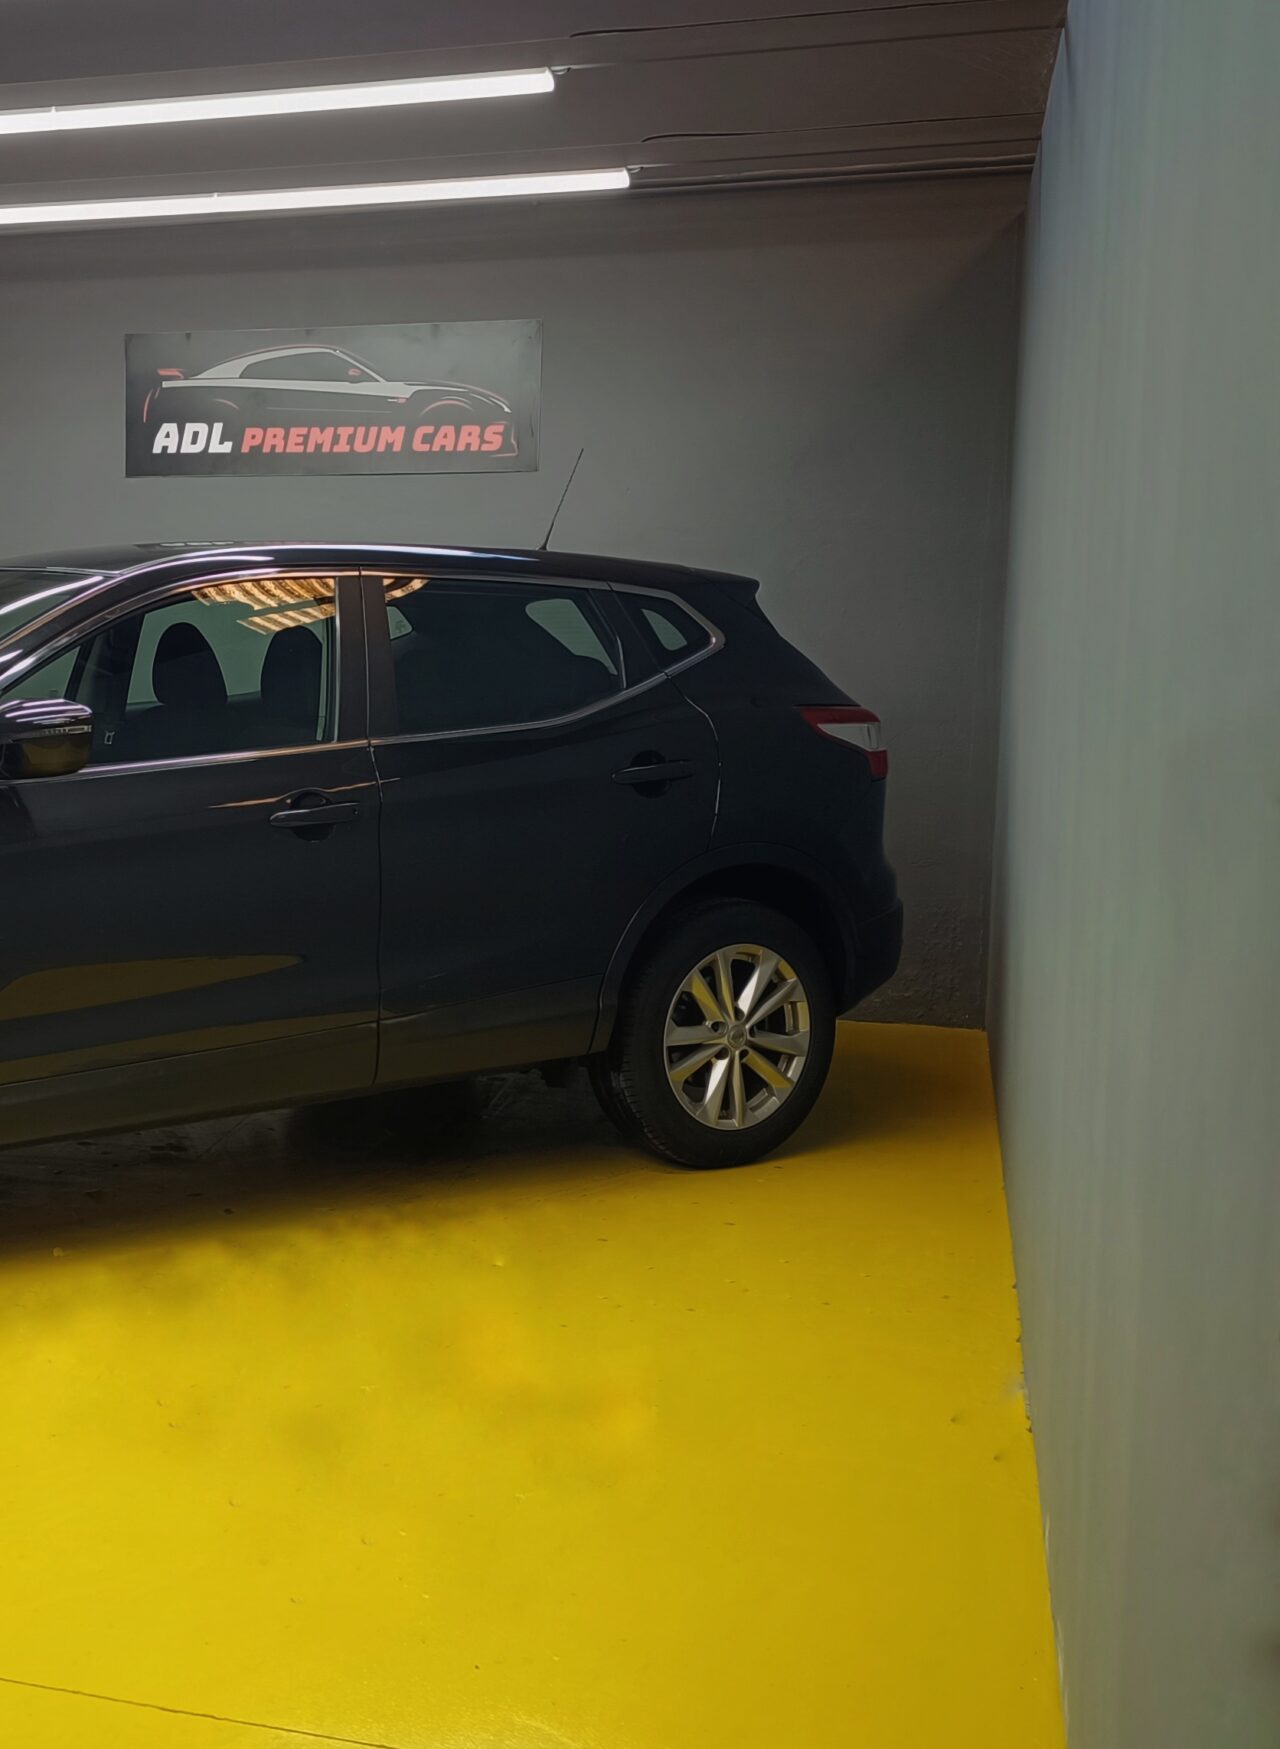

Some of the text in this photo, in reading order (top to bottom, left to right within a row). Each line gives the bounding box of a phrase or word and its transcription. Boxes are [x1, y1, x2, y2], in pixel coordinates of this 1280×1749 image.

[152, 422, 505, 453] ADL PREMIUM CARS
